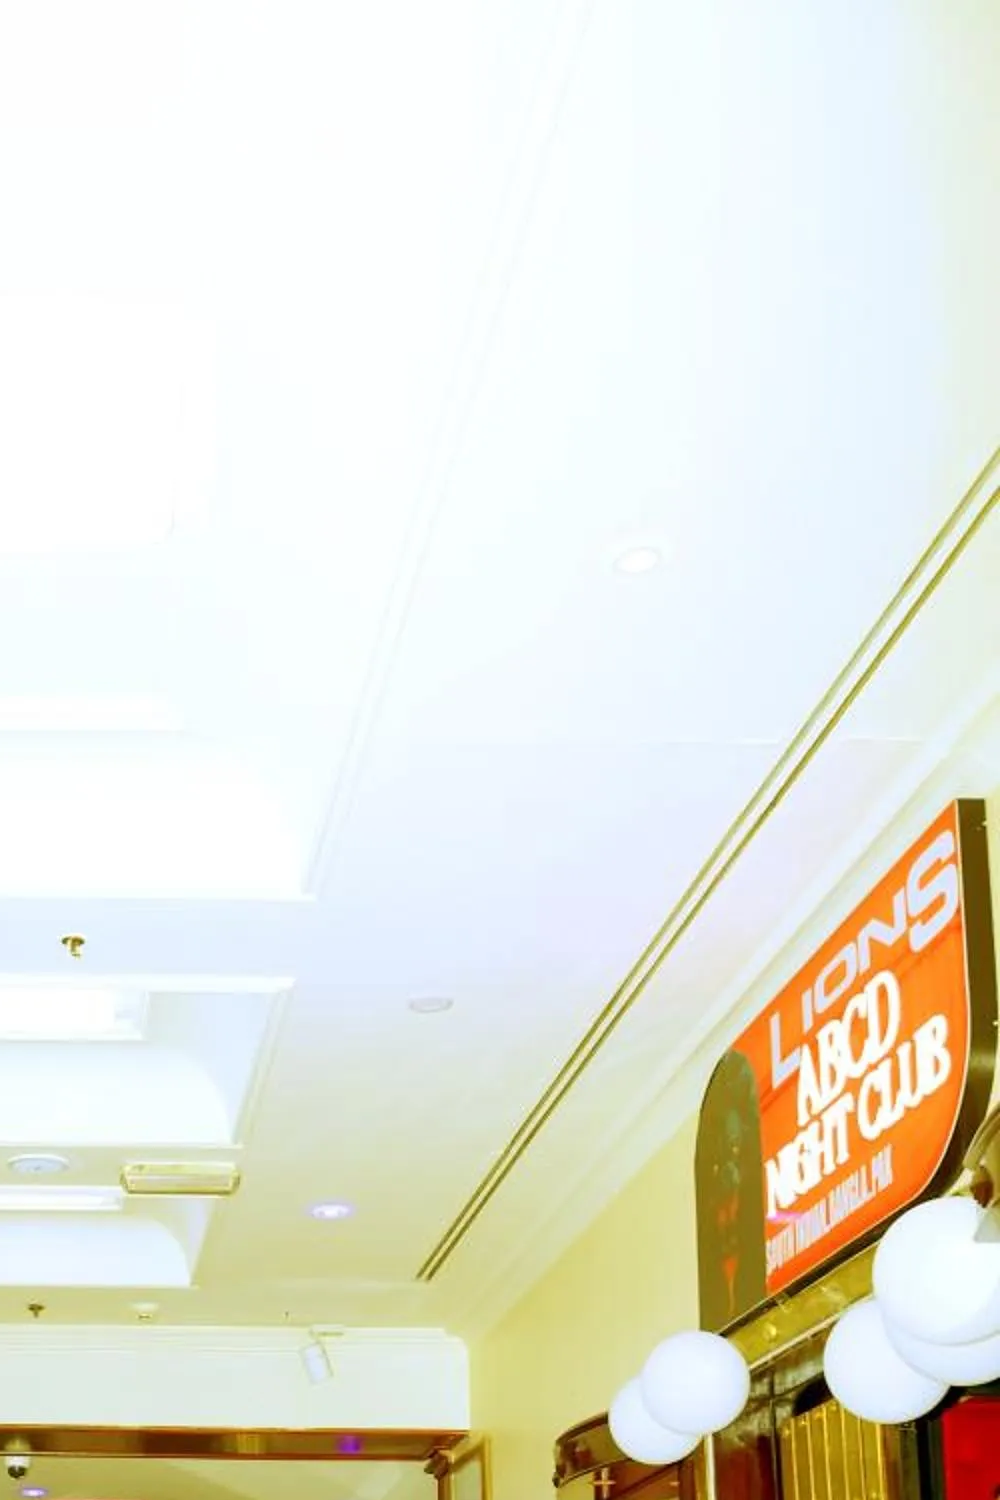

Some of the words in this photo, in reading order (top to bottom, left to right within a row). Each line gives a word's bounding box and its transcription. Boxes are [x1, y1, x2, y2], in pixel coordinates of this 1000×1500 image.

[769, 829, 959, 1090] LIONS
[797, 970, 900, 1127] ABCD
[764, 1092, 854, 1220] NIGHT
[857, 1014, 951, 1140] CLUB
